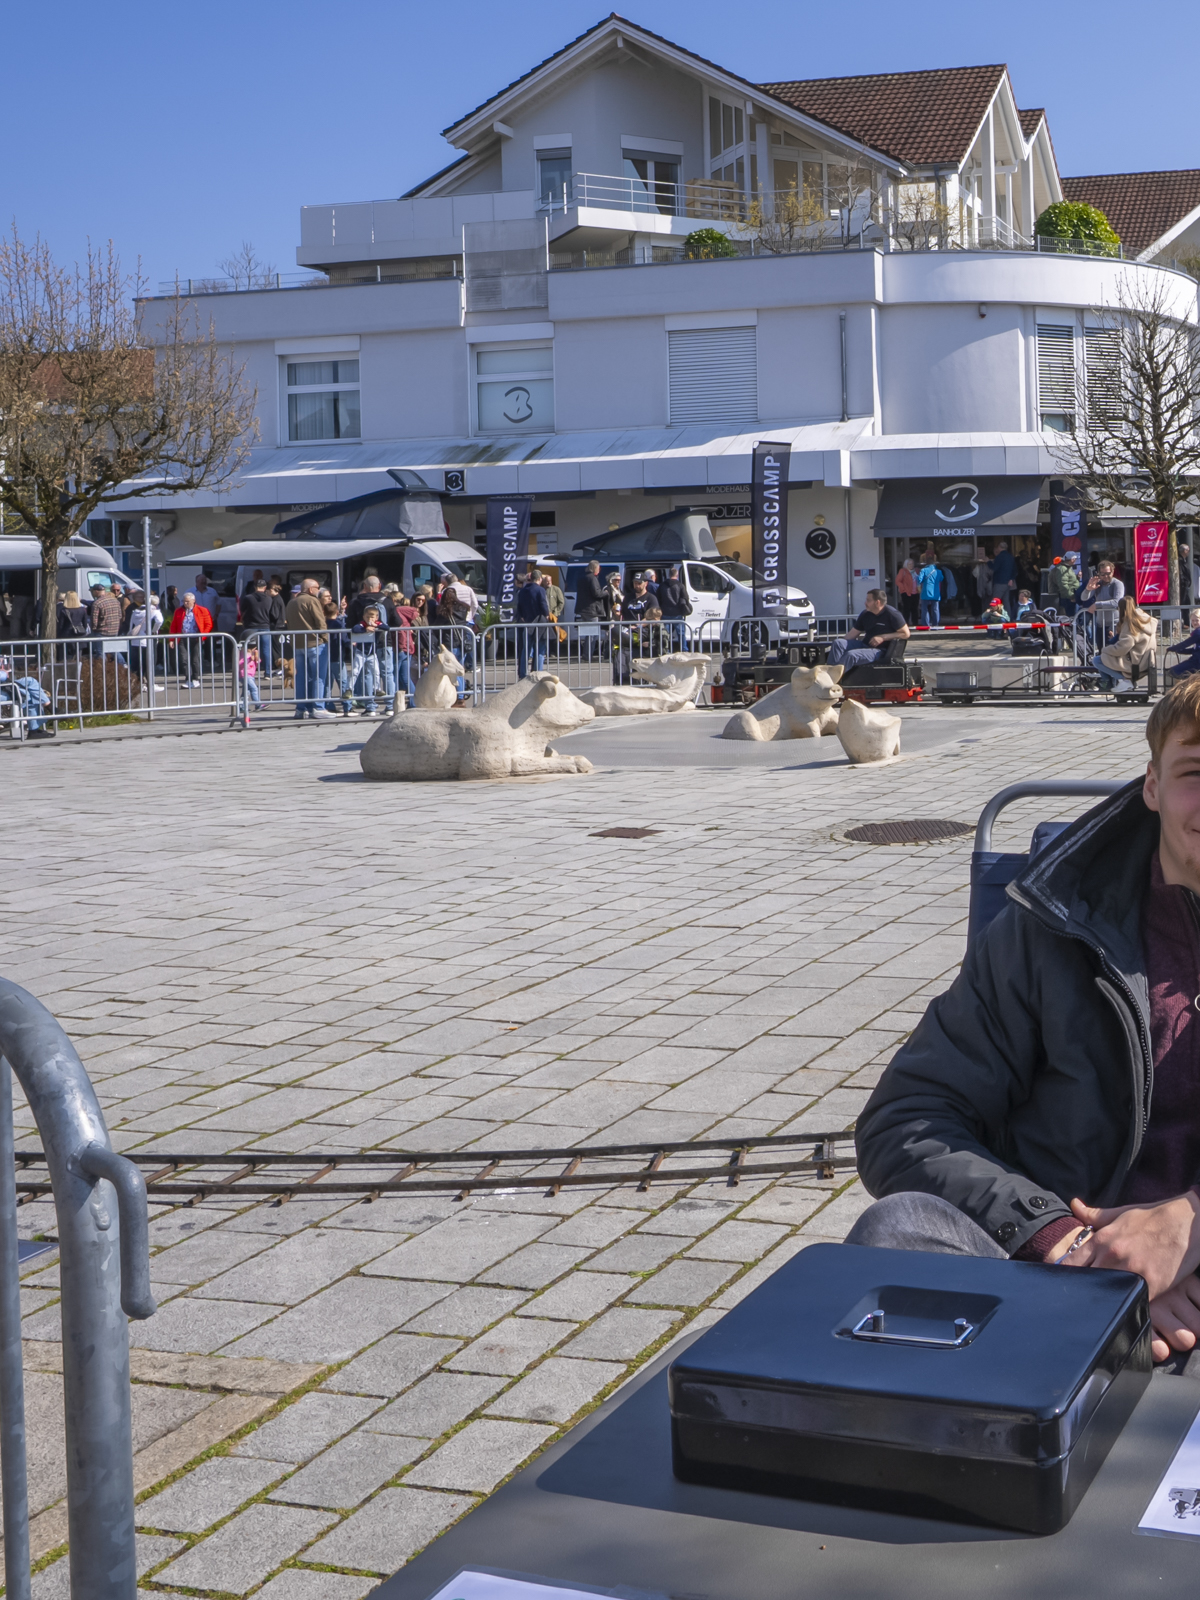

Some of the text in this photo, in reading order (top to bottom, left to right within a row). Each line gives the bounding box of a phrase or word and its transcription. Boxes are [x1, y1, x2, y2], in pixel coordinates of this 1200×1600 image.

[706, 485, 750, 494] MODEHAUS
[763, 455, 781, 581] CROSSCAMP
[933, 528, 975, 536] BANHOLZER
[502, 505, 518, 603] CROSSCAMP
